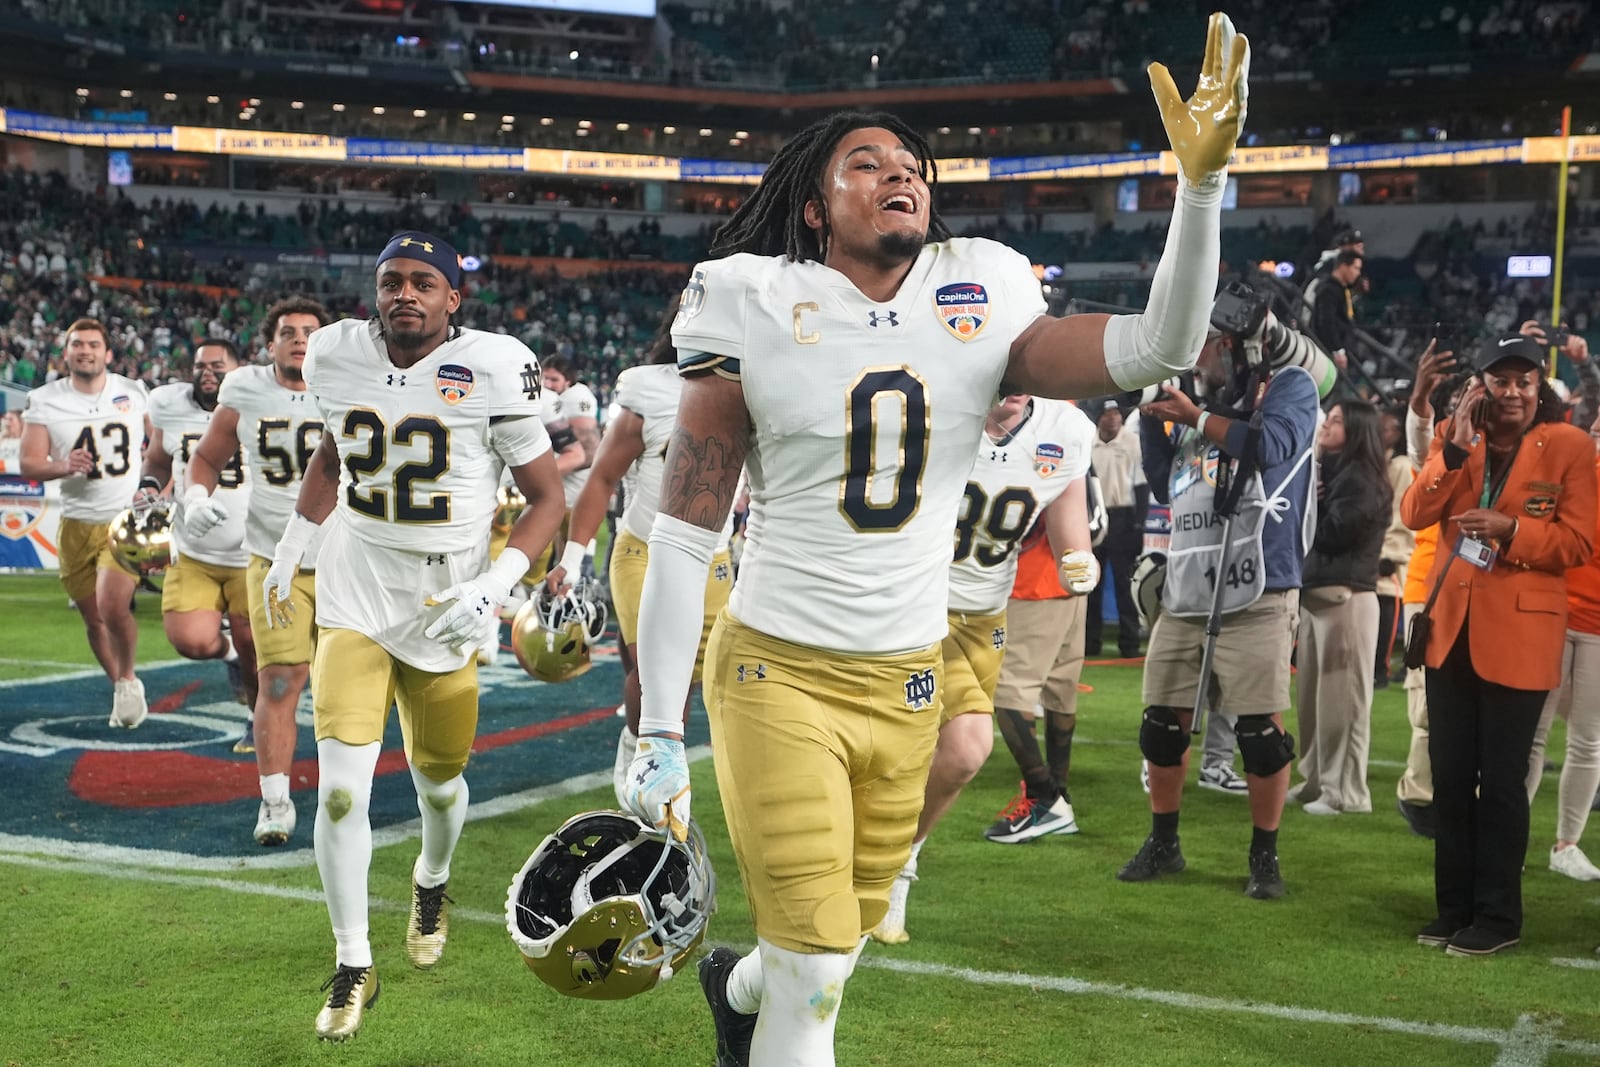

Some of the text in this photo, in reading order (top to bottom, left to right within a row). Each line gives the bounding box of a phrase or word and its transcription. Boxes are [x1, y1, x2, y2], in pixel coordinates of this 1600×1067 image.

[793, 302, 820, 344] C
[72, 421, 131, 481] 43
[341, 406, 452, 524] 22
[838, 363, 931, 534] 0
[1175, 512, 1223, 533] MEDIA
[1204, 558, 1256, 592] 148
